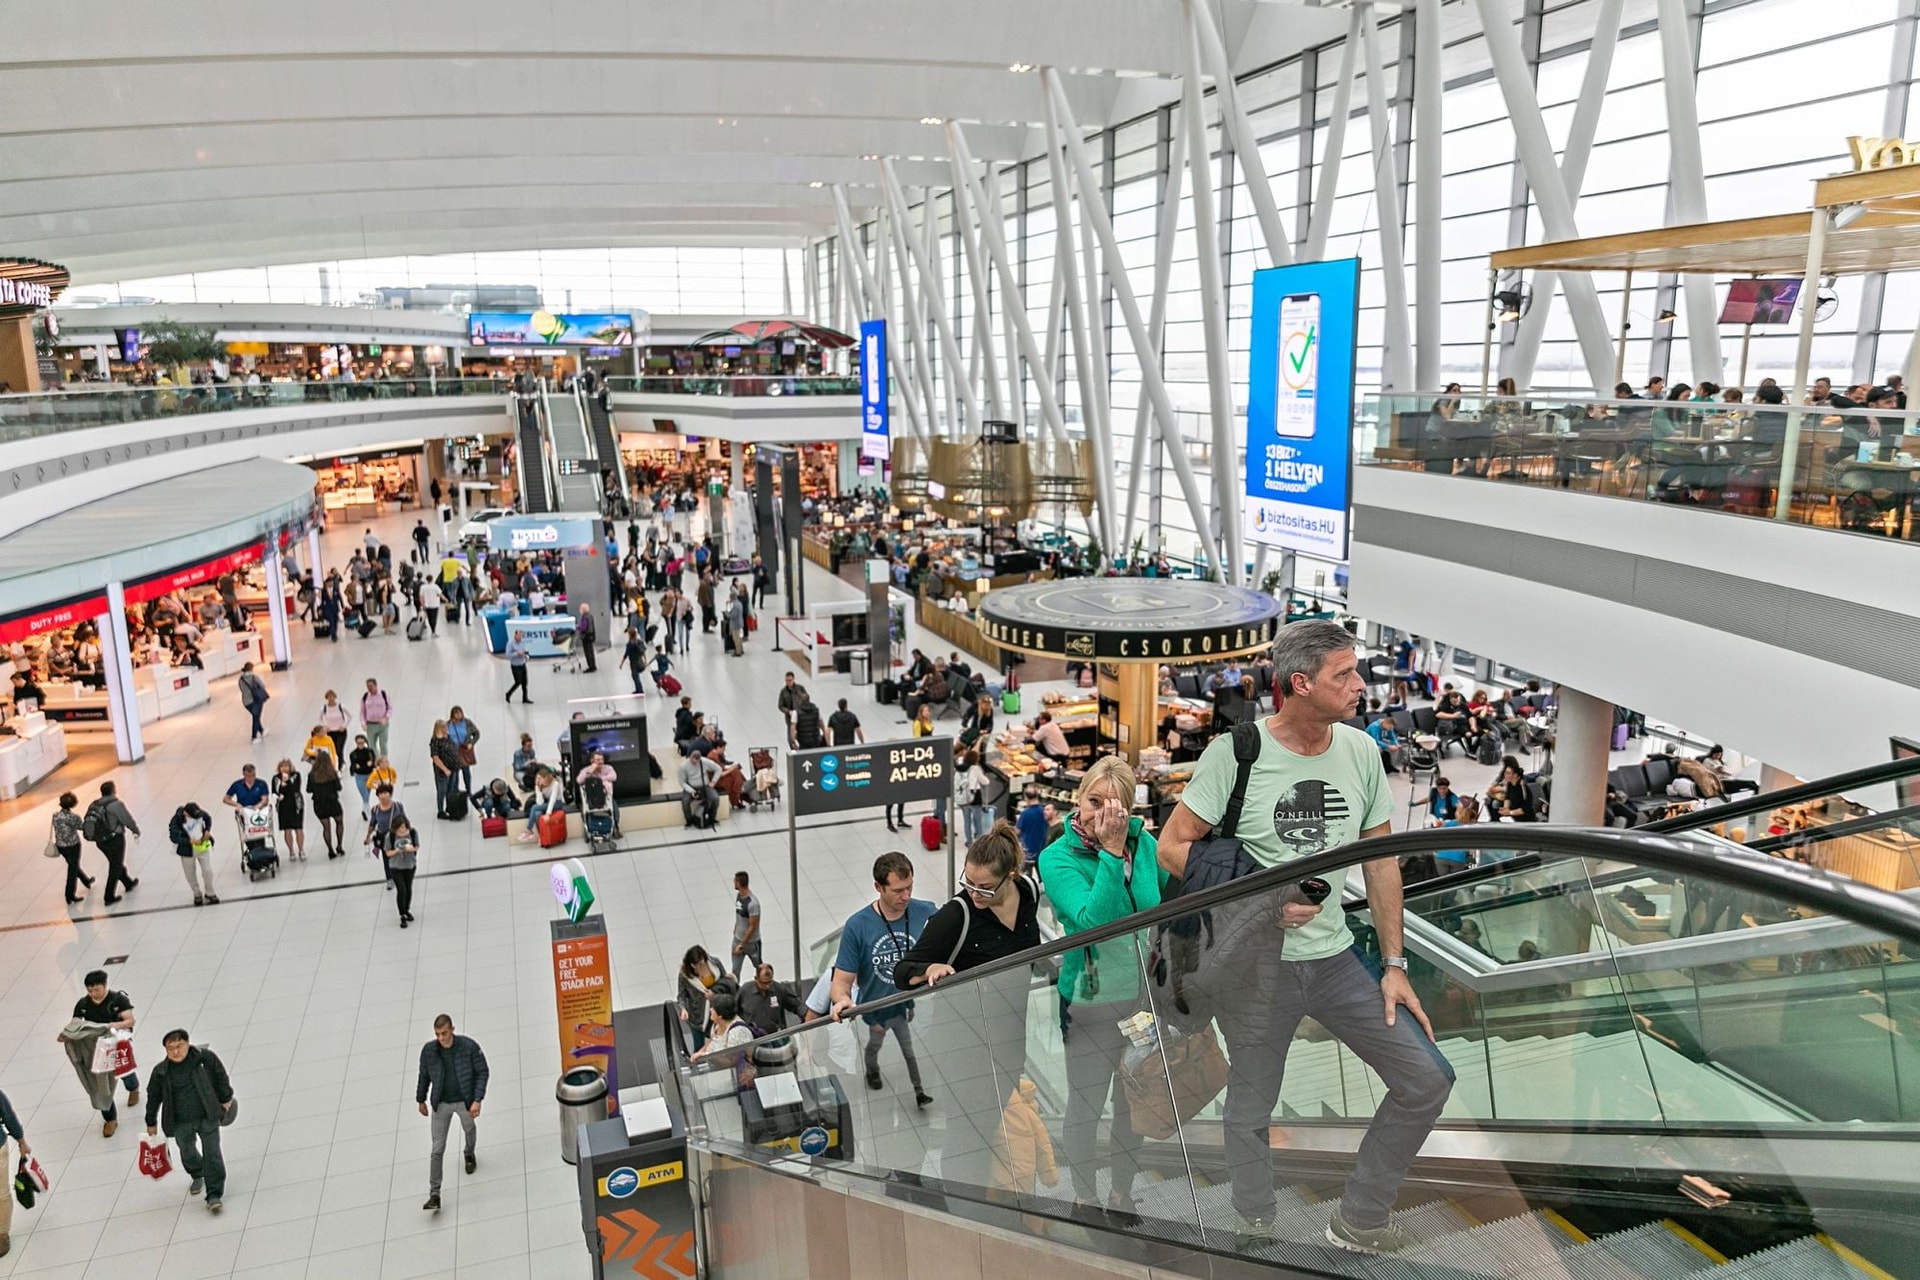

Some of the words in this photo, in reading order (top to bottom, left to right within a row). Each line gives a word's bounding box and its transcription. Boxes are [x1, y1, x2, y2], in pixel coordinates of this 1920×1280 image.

[17, 281, 51, 306] COFFEE
[1265, 459, 1273, 477] 1
[1274, 460, 1323, 485] HELYEN
[30, 617, 52, 630] DUTY
[54, 611, 72, 623] FREE
[890, 746, 934, 764] B1-D4
[889, 763, 942, 783] A1-A19
[1275, 811, 1323, 820] O'NEILL
[559, 957, 573, 969] GET
[574, 955, 594, 967] YOUR
[560, 968, 578, 980] FREE
[560, 979, 585, 991] SNACK
[584, 976, 605, 988] PACK
[648, 1168, 675, 1180] ATM
